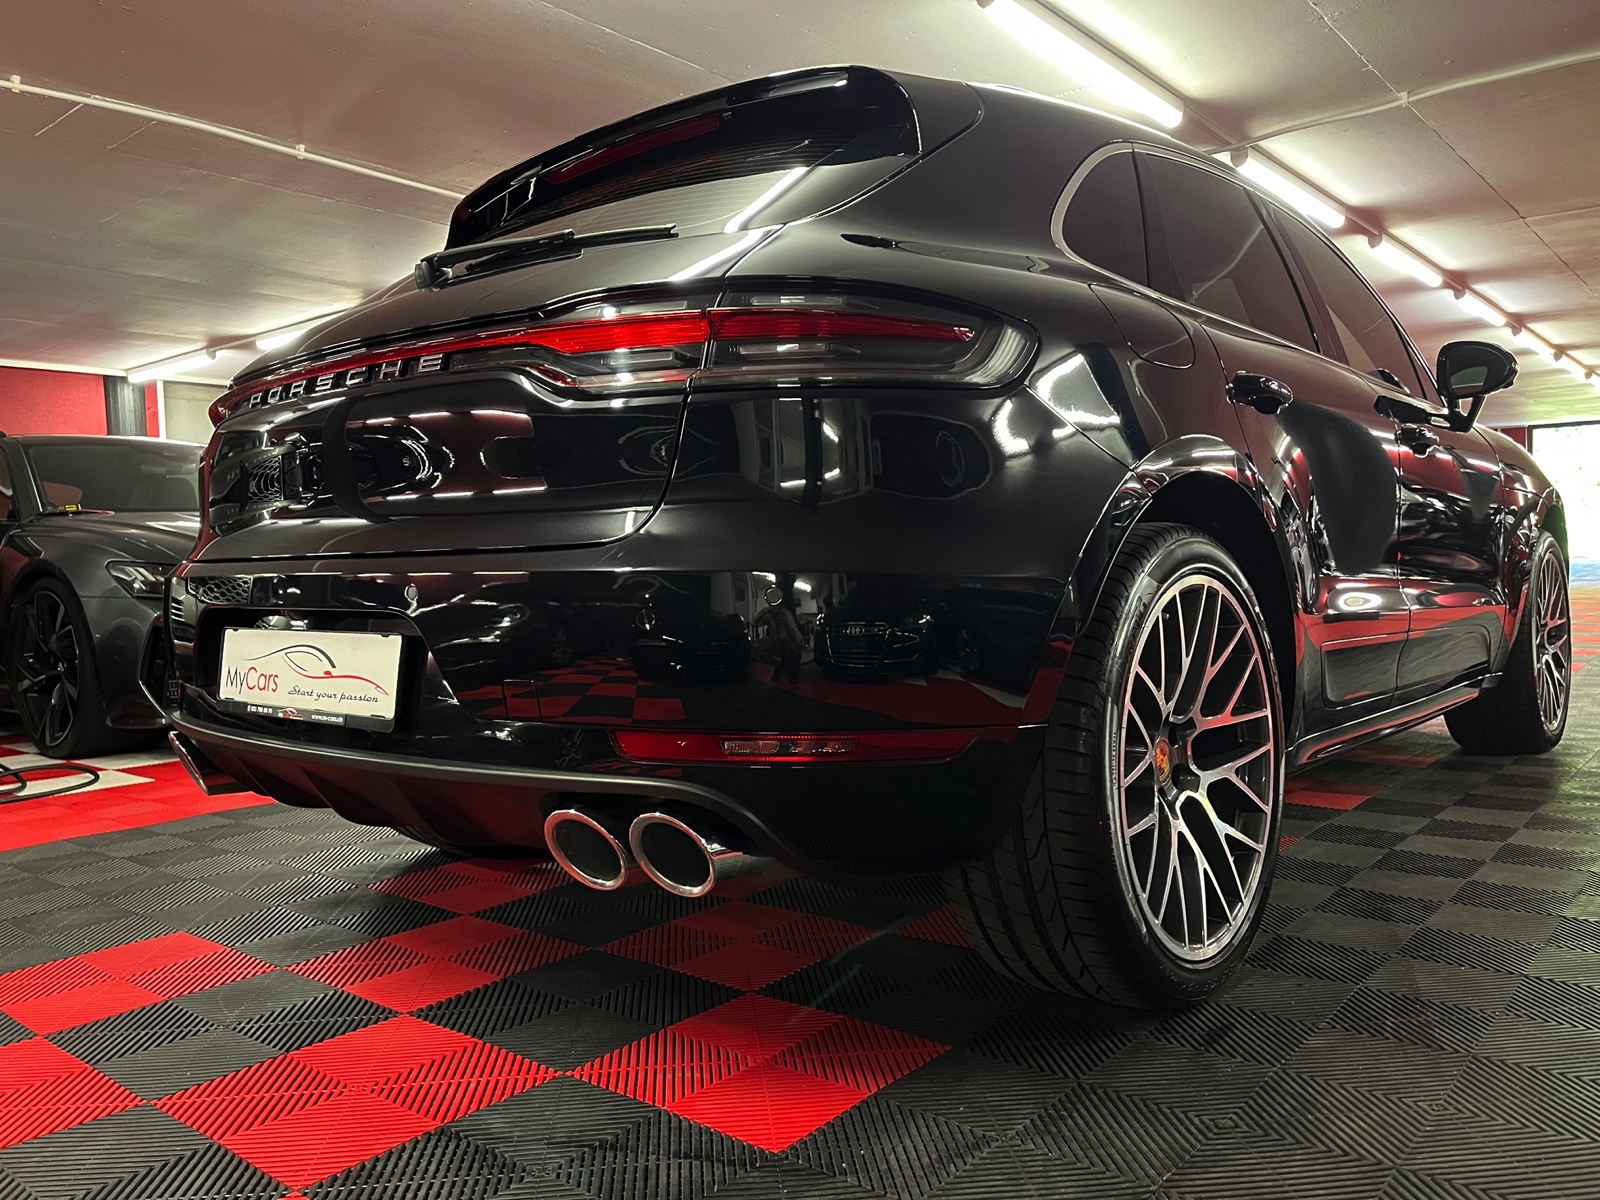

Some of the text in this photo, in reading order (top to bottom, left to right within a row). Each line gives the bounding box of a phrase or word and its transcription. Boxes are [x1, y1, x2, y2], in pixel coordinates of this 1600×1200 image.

[249, 353, 444, 408] PORSCHE
[225, 665, 279, 694] MyCars
[288, 685, 379, 703] Start your passion
